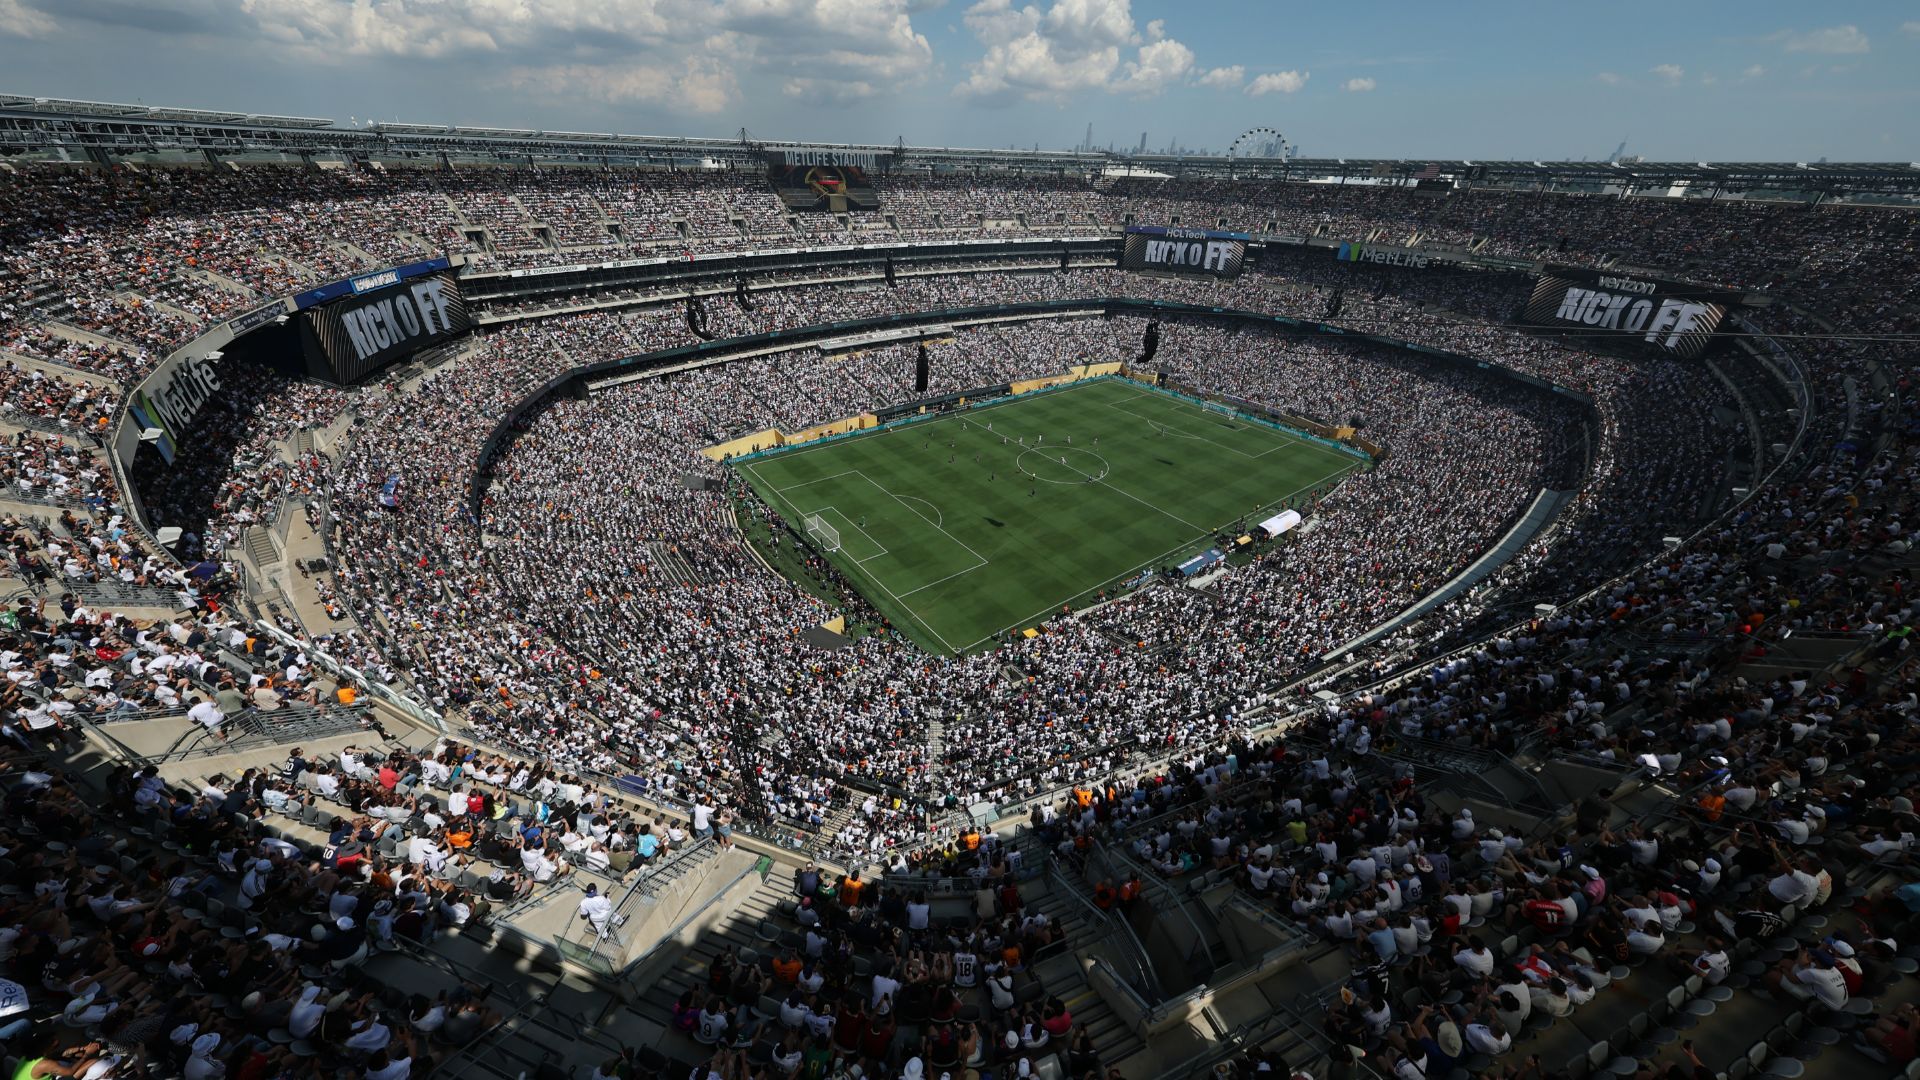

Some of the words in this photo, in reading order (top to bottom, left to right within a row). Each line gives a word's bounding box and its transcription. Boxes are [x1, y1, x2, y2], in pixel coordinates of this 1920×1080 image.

[784, 151, 829, 166] METLIFE
[832, 152, 877, 168] STADIUM
[1166, 228, 1206, 239] HCLTech
[1144, 240, 1189, 265] KICK
[1360, 247, 1429, 269] MetLife
[1598, 275, 1656, 295] verizon
[1556, 287, 1632, 330] KICK
[341, 297, 406, 360] KICK
[149, 355, 221, 441] MetLife
[1545, 910, 1559, 924] 11
[959, 962, 972, 977] 18
[1381, 977, 1389, 994] 7
[1836, 983, 1847, 1001] 7
[703, 1023, 712, 1037] 9
